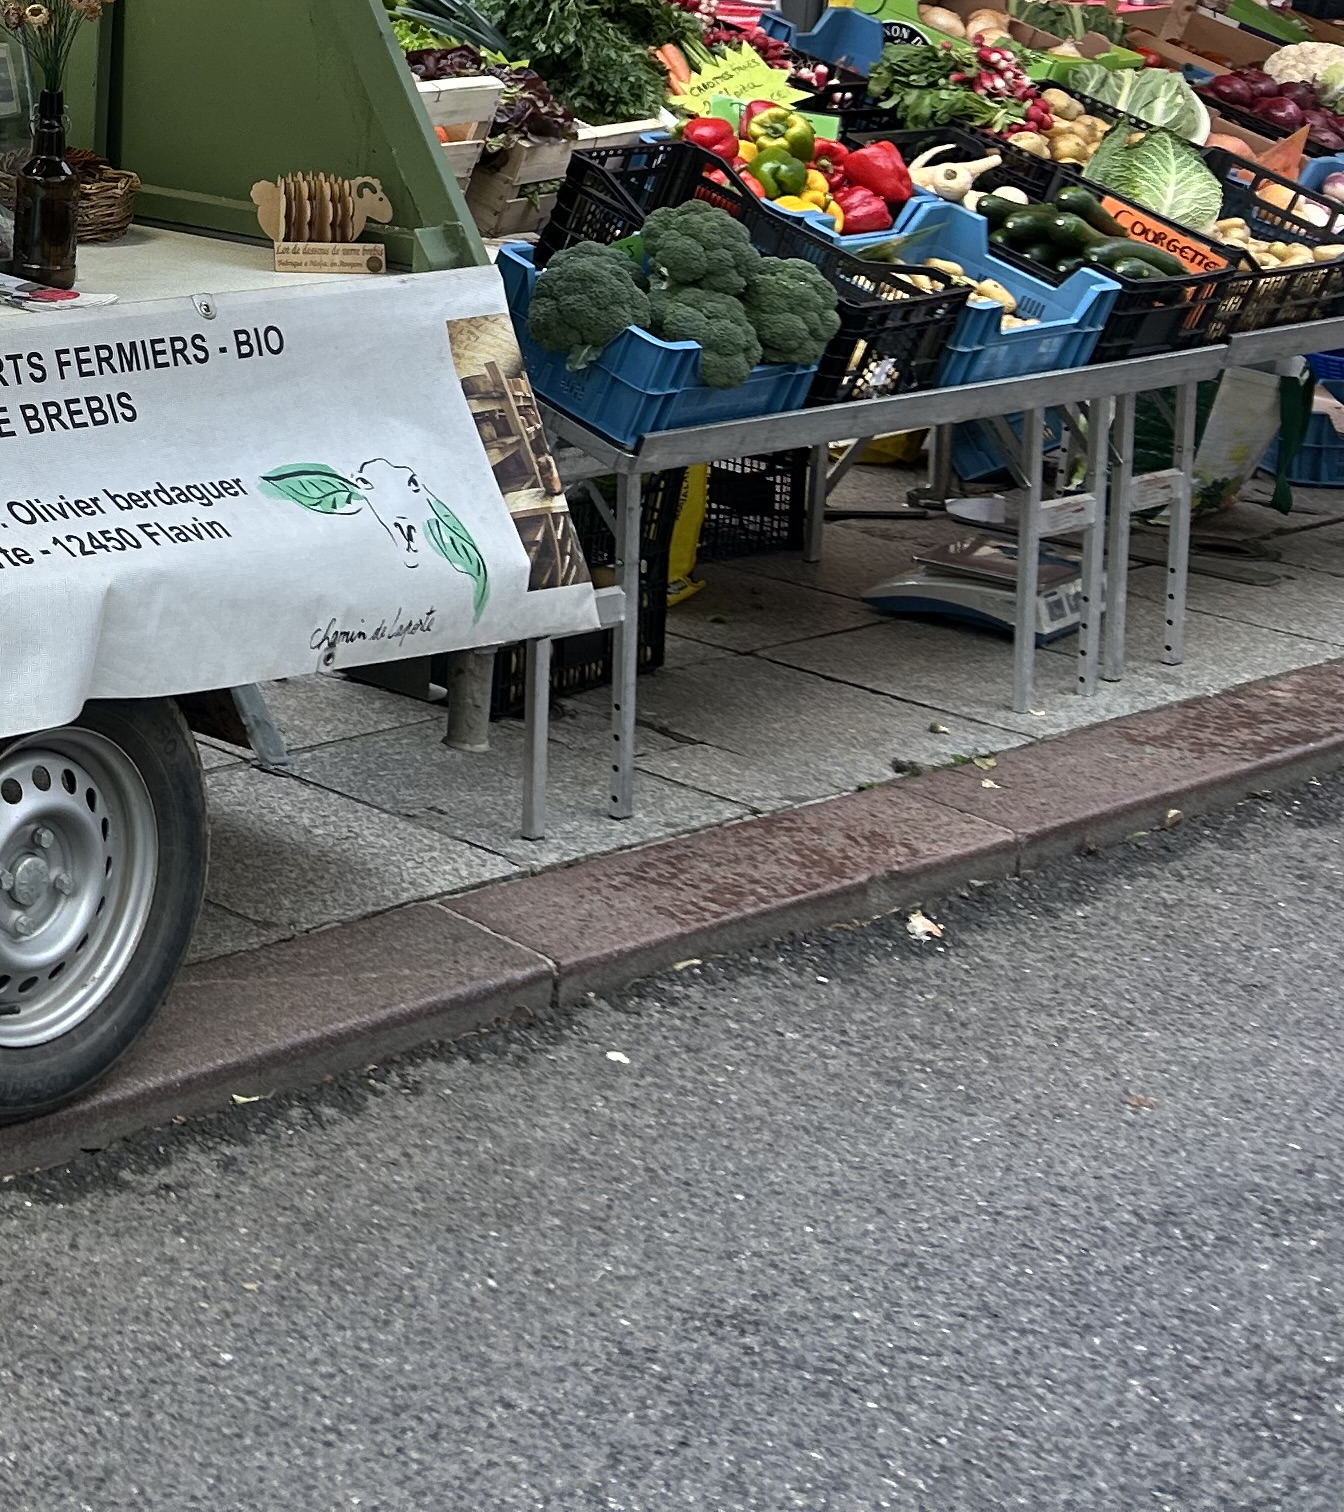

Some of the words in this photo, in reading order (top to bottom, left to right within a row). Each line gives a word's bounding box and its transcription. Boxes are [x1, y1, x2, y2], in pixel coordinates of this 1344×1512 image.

[55, 332, 214, 387] FERMIERS
[233, 324, 286, 361] BIO
[21, 390, 139, 438] BREBIS
[5, 490, 103, 529] Olivier
[104, 472, 250, 520] berdaguer
[50, 527, 141, 562] 12450
[143, 514, 233, 550] Flavin
[369, 618, 388, 641] de
